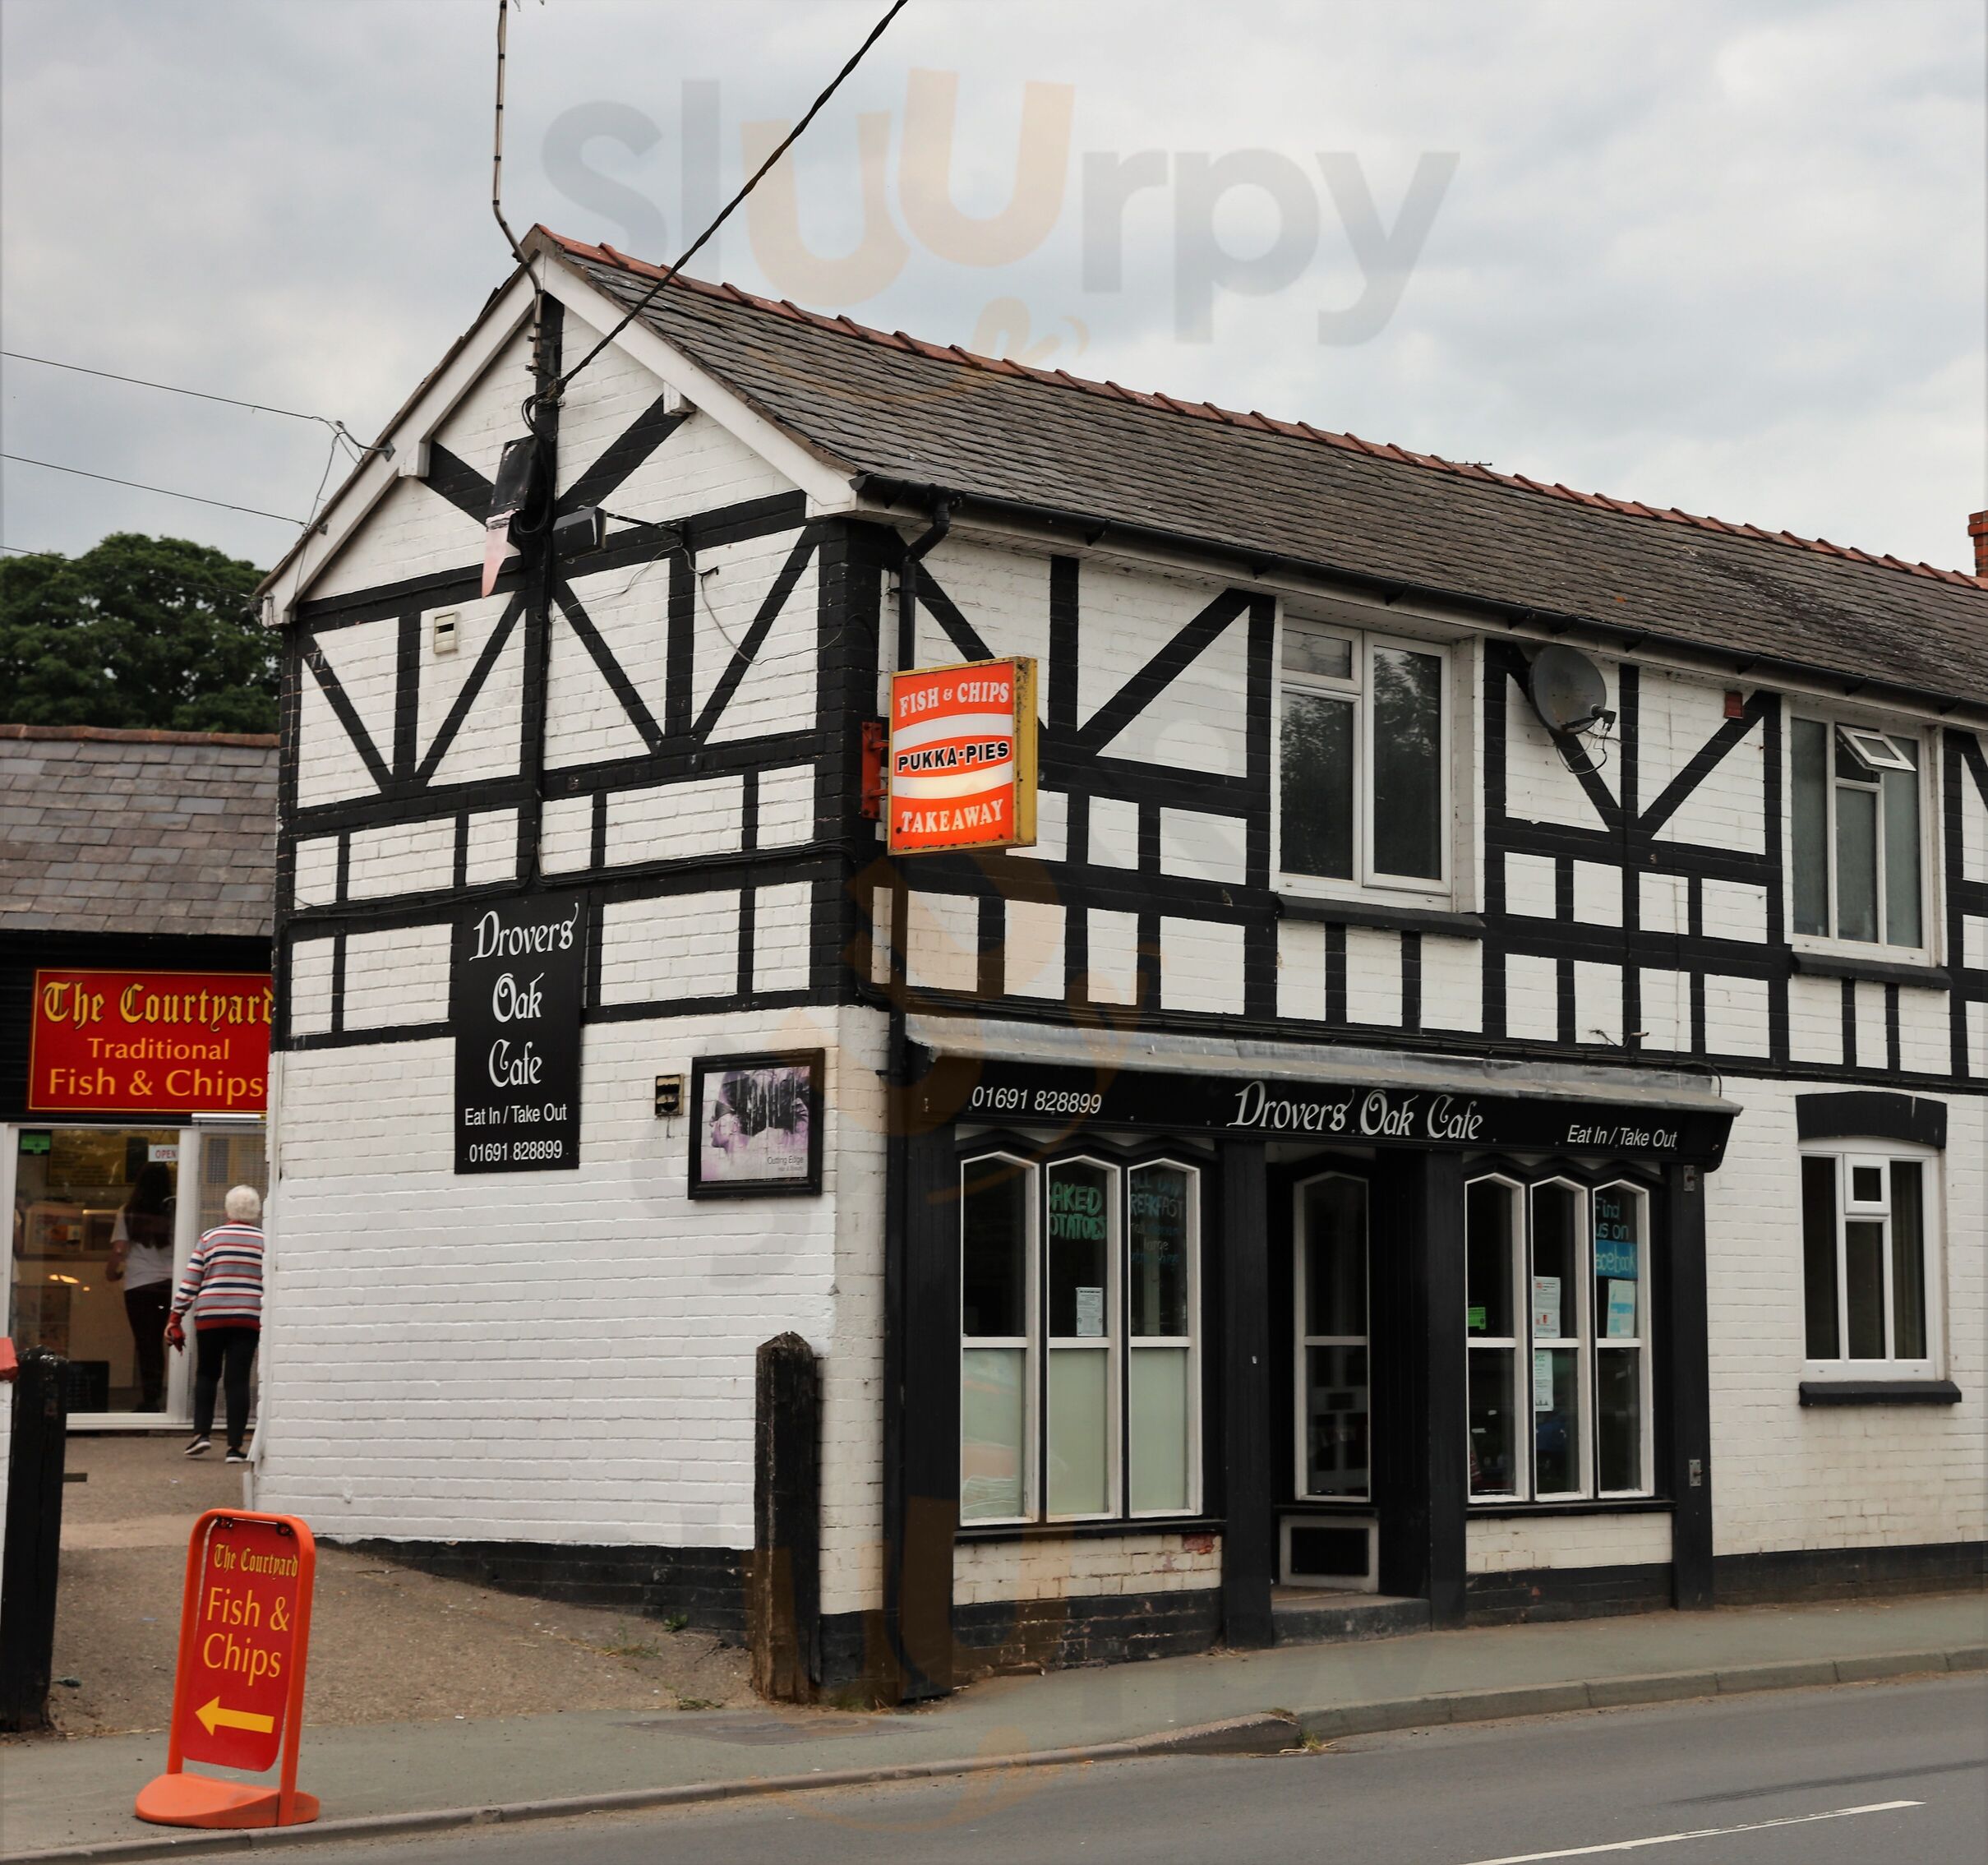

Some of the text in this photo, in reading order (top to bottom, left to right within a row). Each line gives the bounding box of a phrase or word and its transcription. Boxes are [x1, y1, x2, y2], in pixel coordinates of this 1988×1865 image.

[899, 681, 1009, 718] FISH & CHIPS
[902, 798, 1004, 833] TAKEAWAY
[43, 981, 272, 1032] The Courtyard
[491, 972, 545, 1023] Oak
[87, 1038, 230, 1060] Traditional
[488, 1039, 542, 1088] Cafe
[48, 1068, 264, 1106] Fish & Chips
[971, 1086, 1102, 1115] 01691 828899
[464, 1107, 486, 1126] Eat
[488, 1106, 500, 1124] In
[511, 1105, 541, 1124] Take
[543, 1103, 567, 1122] Out
[1360, 1089, 1419, 1137] Oak
[1427, 1094, 1483, 1140] Cafe
[469, 1140, 562, 1163] 01691 828899
[1567, 1124, 1591, 1143] Eat
[1594, 1125, 1607, 1145] In
[1620, 1127, 1649, 1147] Take
[1653, 1129, 1678, 1147] Out
[155, 1148, 178, 1160] OPEN
[1049, 1181, 1102, 1215] AKED
[1131, 1193, 1183, 1220] REAKFAST
[1049, 1212, 1107, 1241] OTATOES
[1596, 1244, 1637, 1273] acebook
[214, 1543, 299, 1577] The Courtyard
[207, 1586, 289, 1632] Fish &
[203, 1632, 282, 1687] Chips
